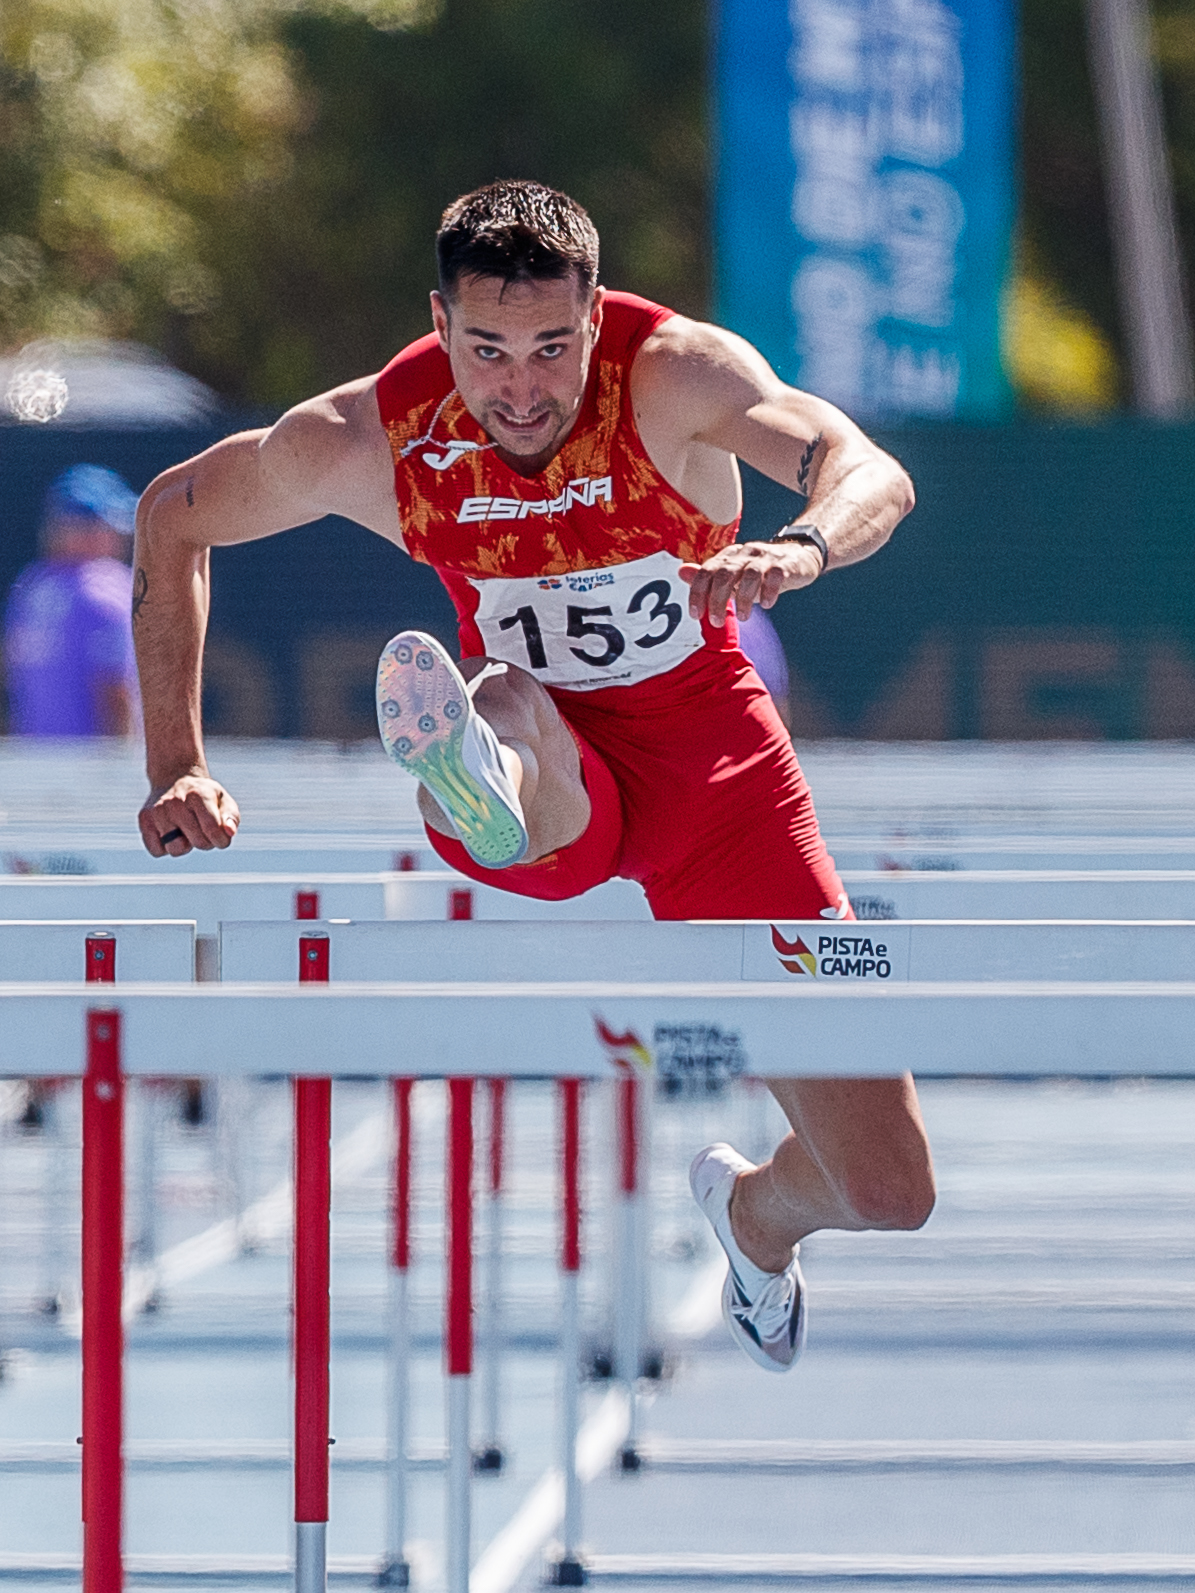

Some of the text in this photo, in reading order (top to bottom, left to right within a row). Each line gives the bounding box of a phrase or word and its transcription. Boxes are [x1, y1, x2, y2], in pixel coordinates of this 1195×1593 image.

[569, 581, 615, 592] CAI
[498, 580, 682, 668] 153
[820, 957, 891, 978] CAMPO
